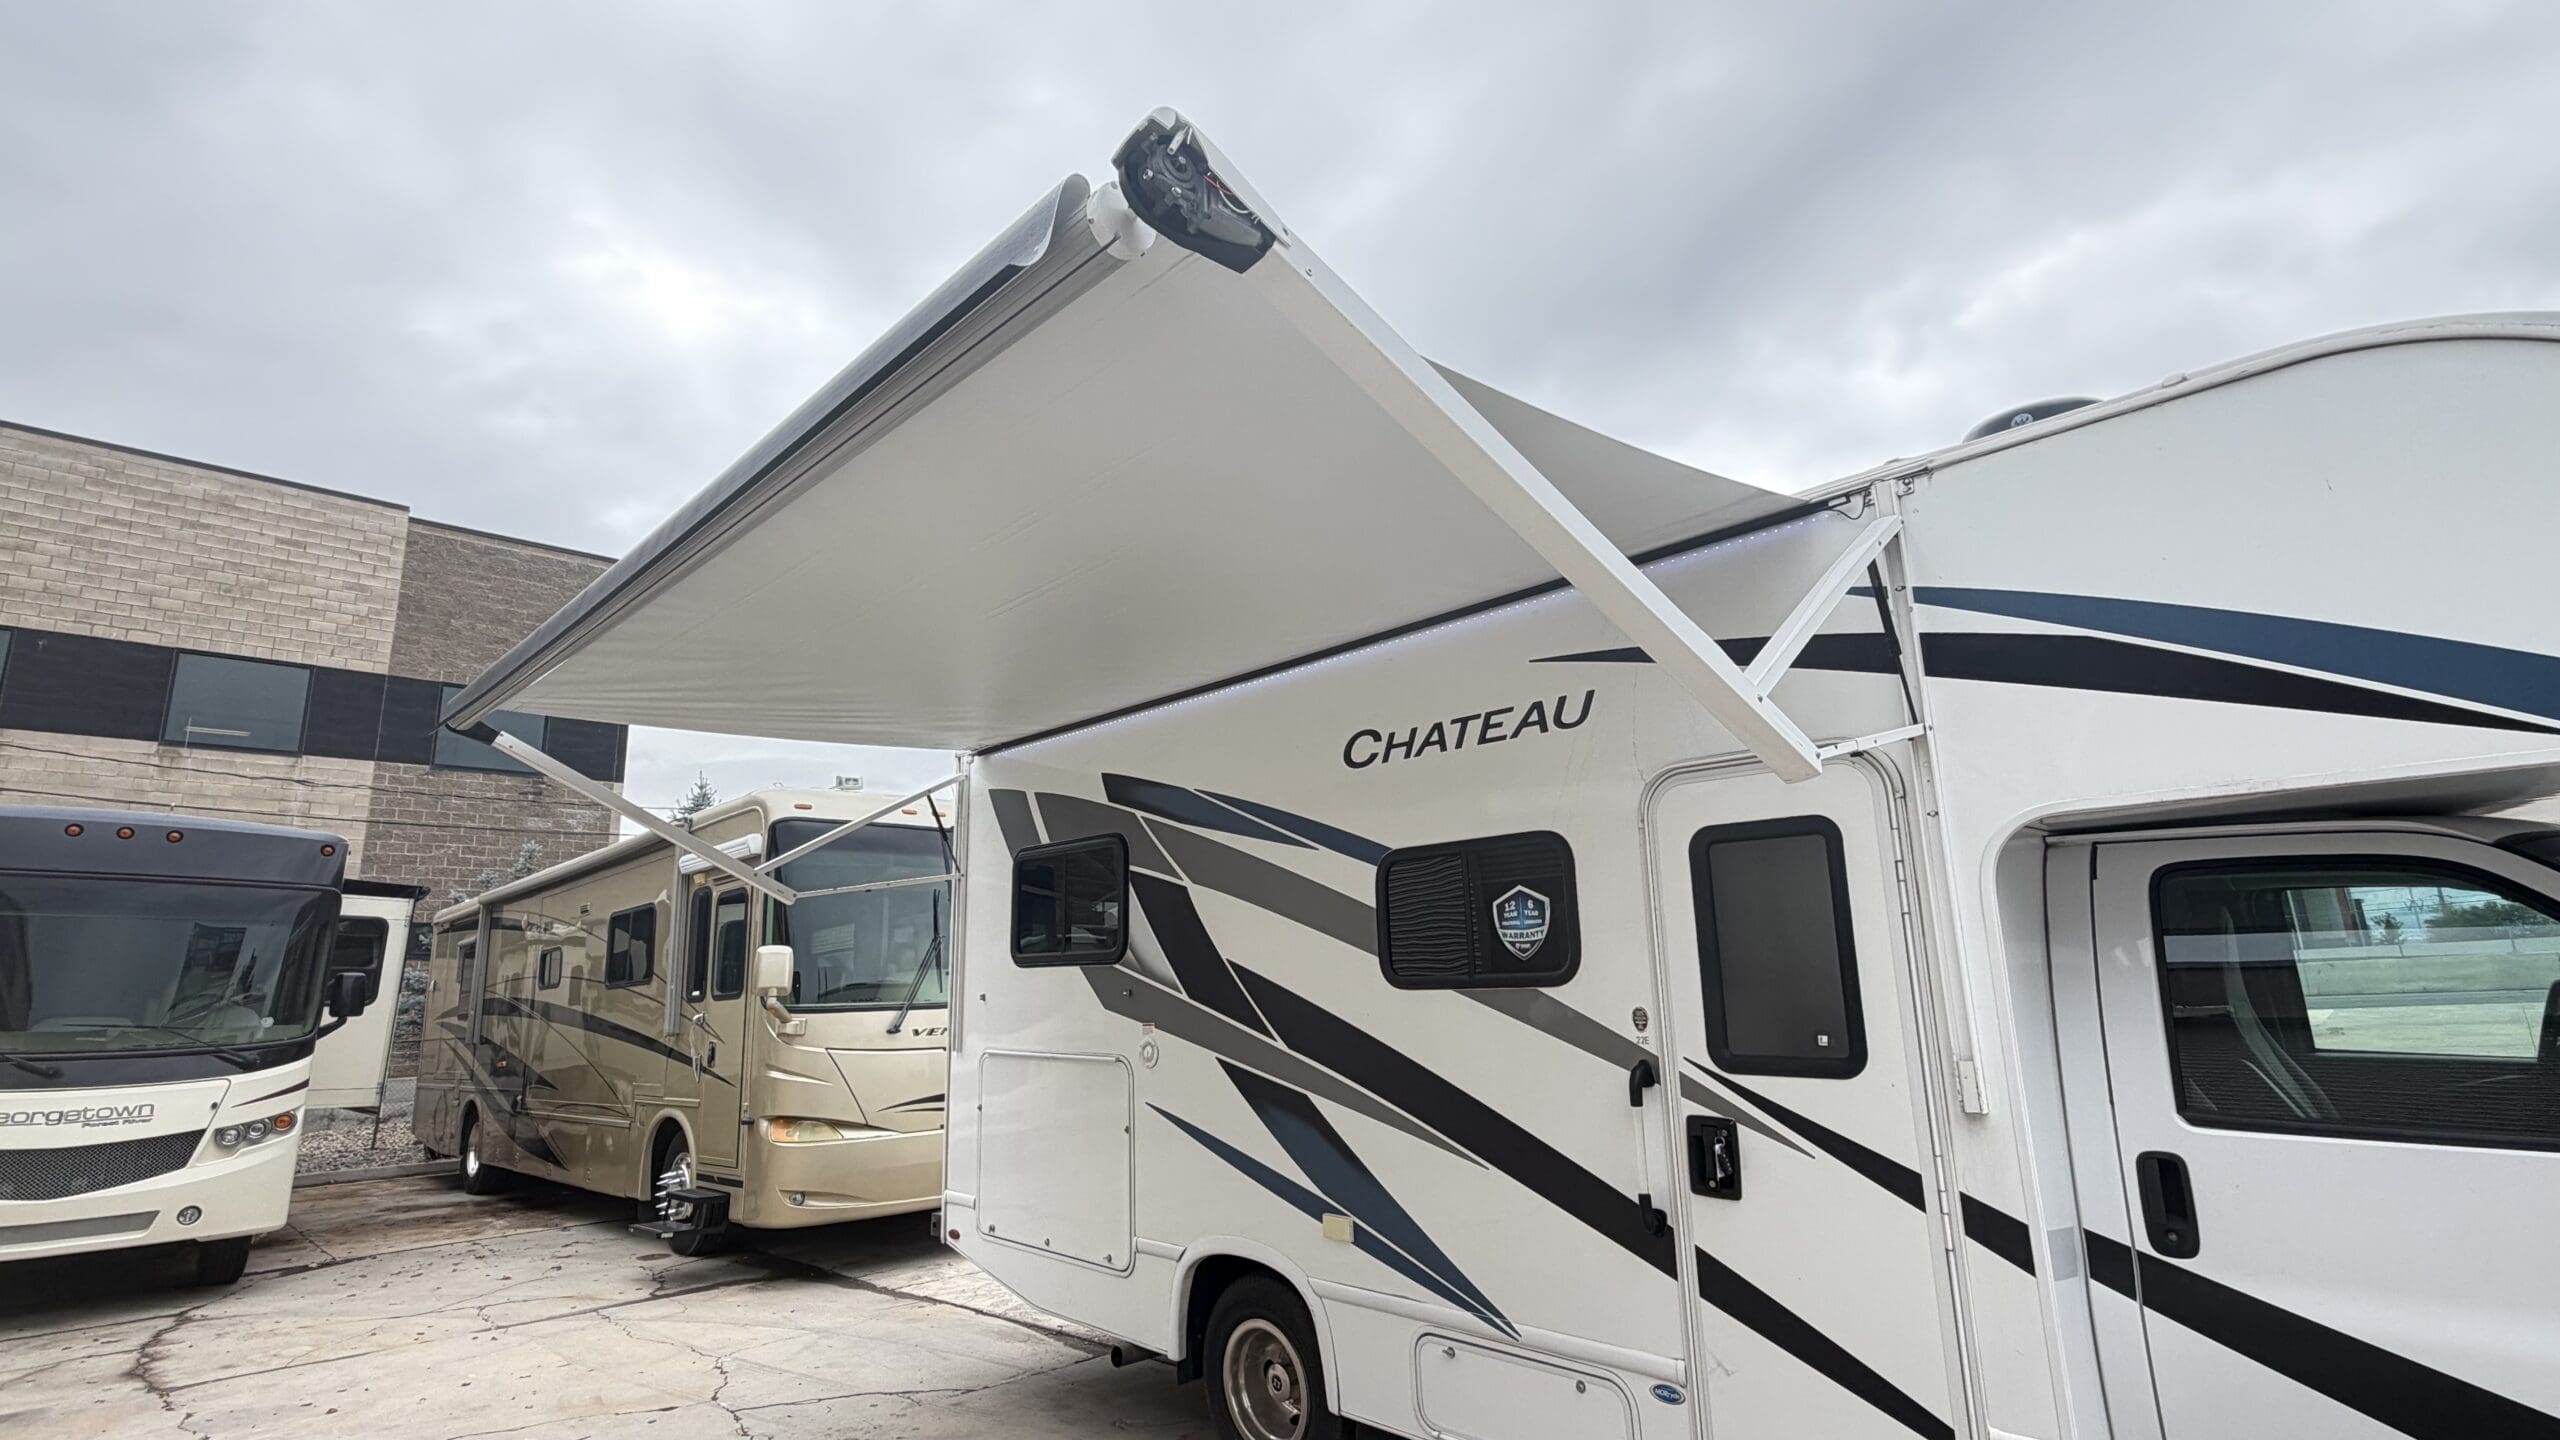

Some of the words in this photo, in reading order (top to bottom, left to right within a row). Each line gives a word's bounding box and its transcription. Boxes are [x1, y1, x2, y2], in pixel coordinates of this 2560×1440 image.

[1343, 689, 1596, 769] CHATEAU
[1504, 901, 1516, 912] 12
[1527, 899, 1534, 909] 6
[1501, 929, 1545, 940] WARRANTY
